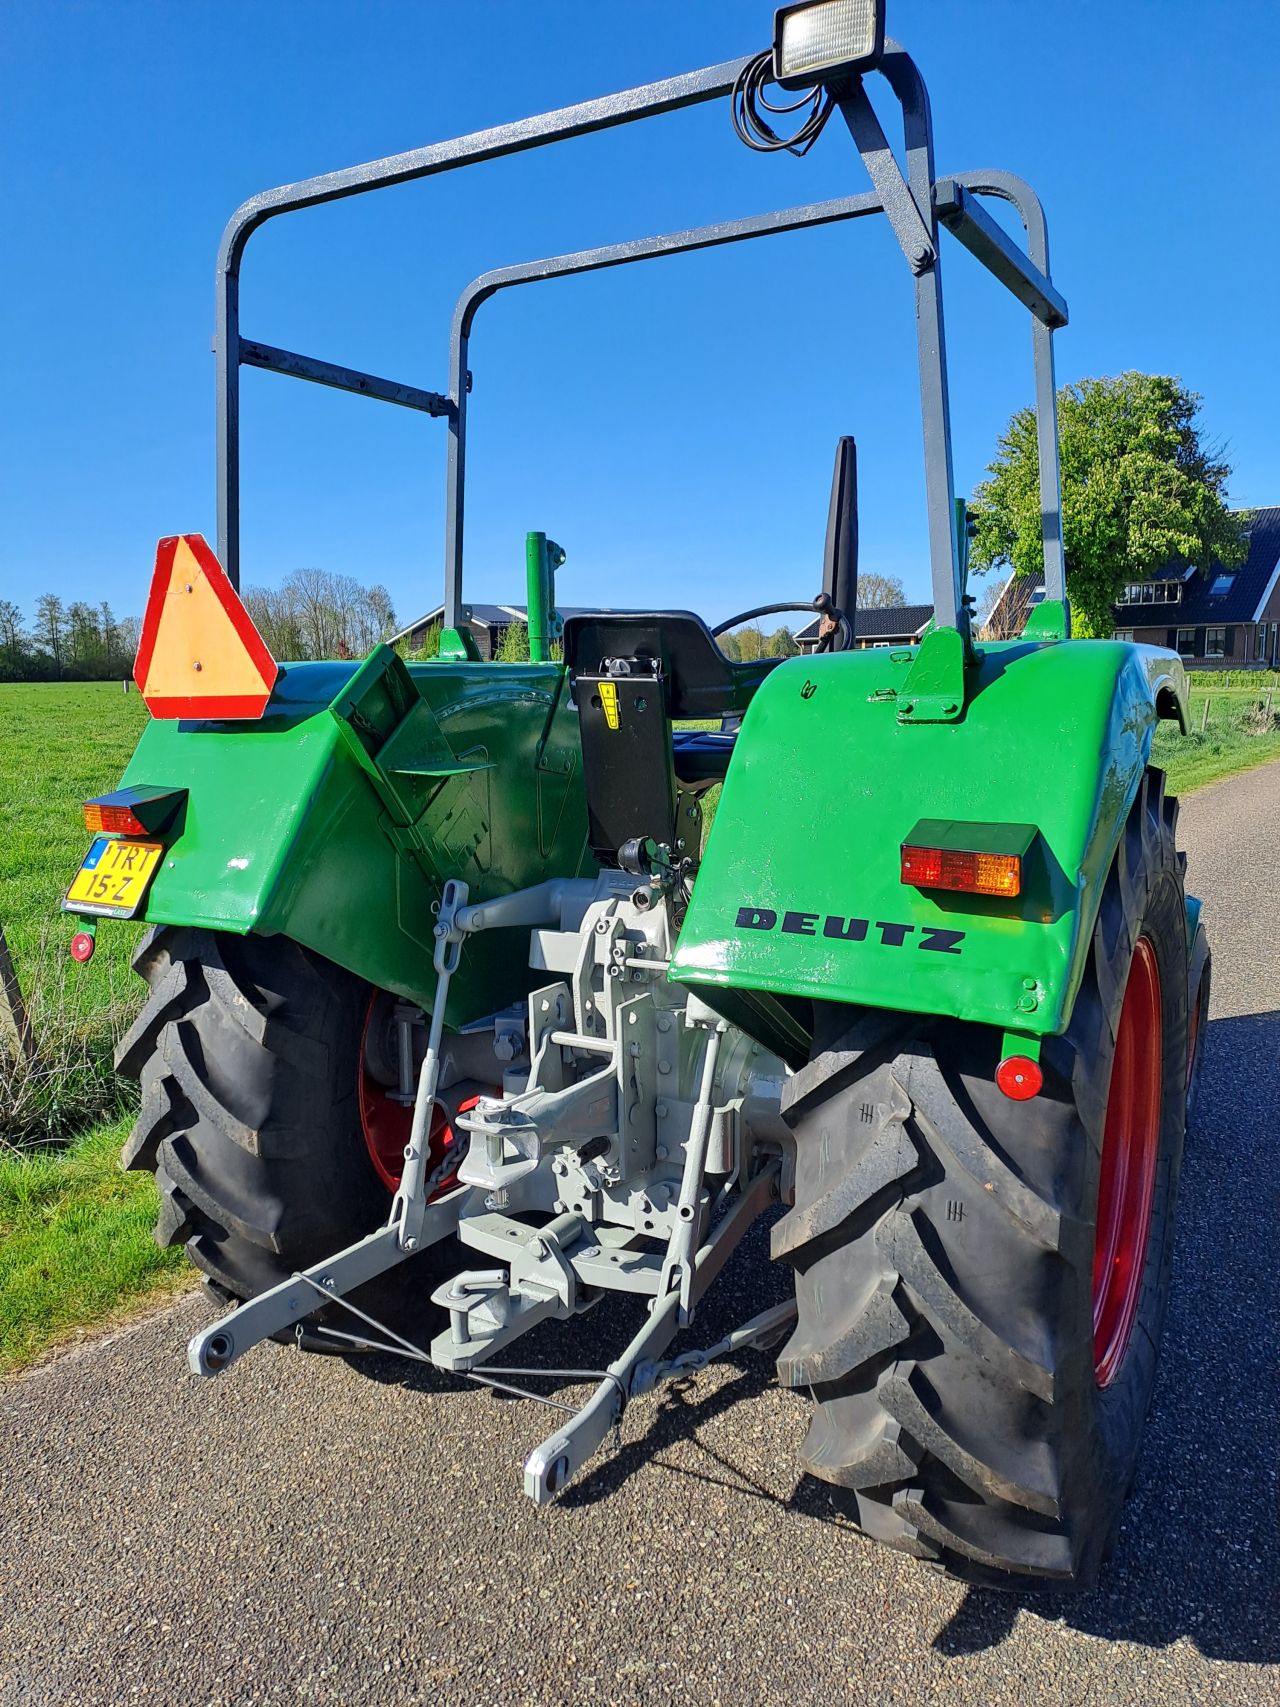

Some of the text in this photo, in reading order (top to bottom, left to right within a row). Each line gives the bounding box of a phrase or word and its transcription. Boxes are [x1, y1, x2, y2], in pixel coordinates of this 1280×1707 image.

[88, 858, 97, 866] NL
[111, 845, 155, 872] TRT
[734, 907, 966, 955] DEUTZ
